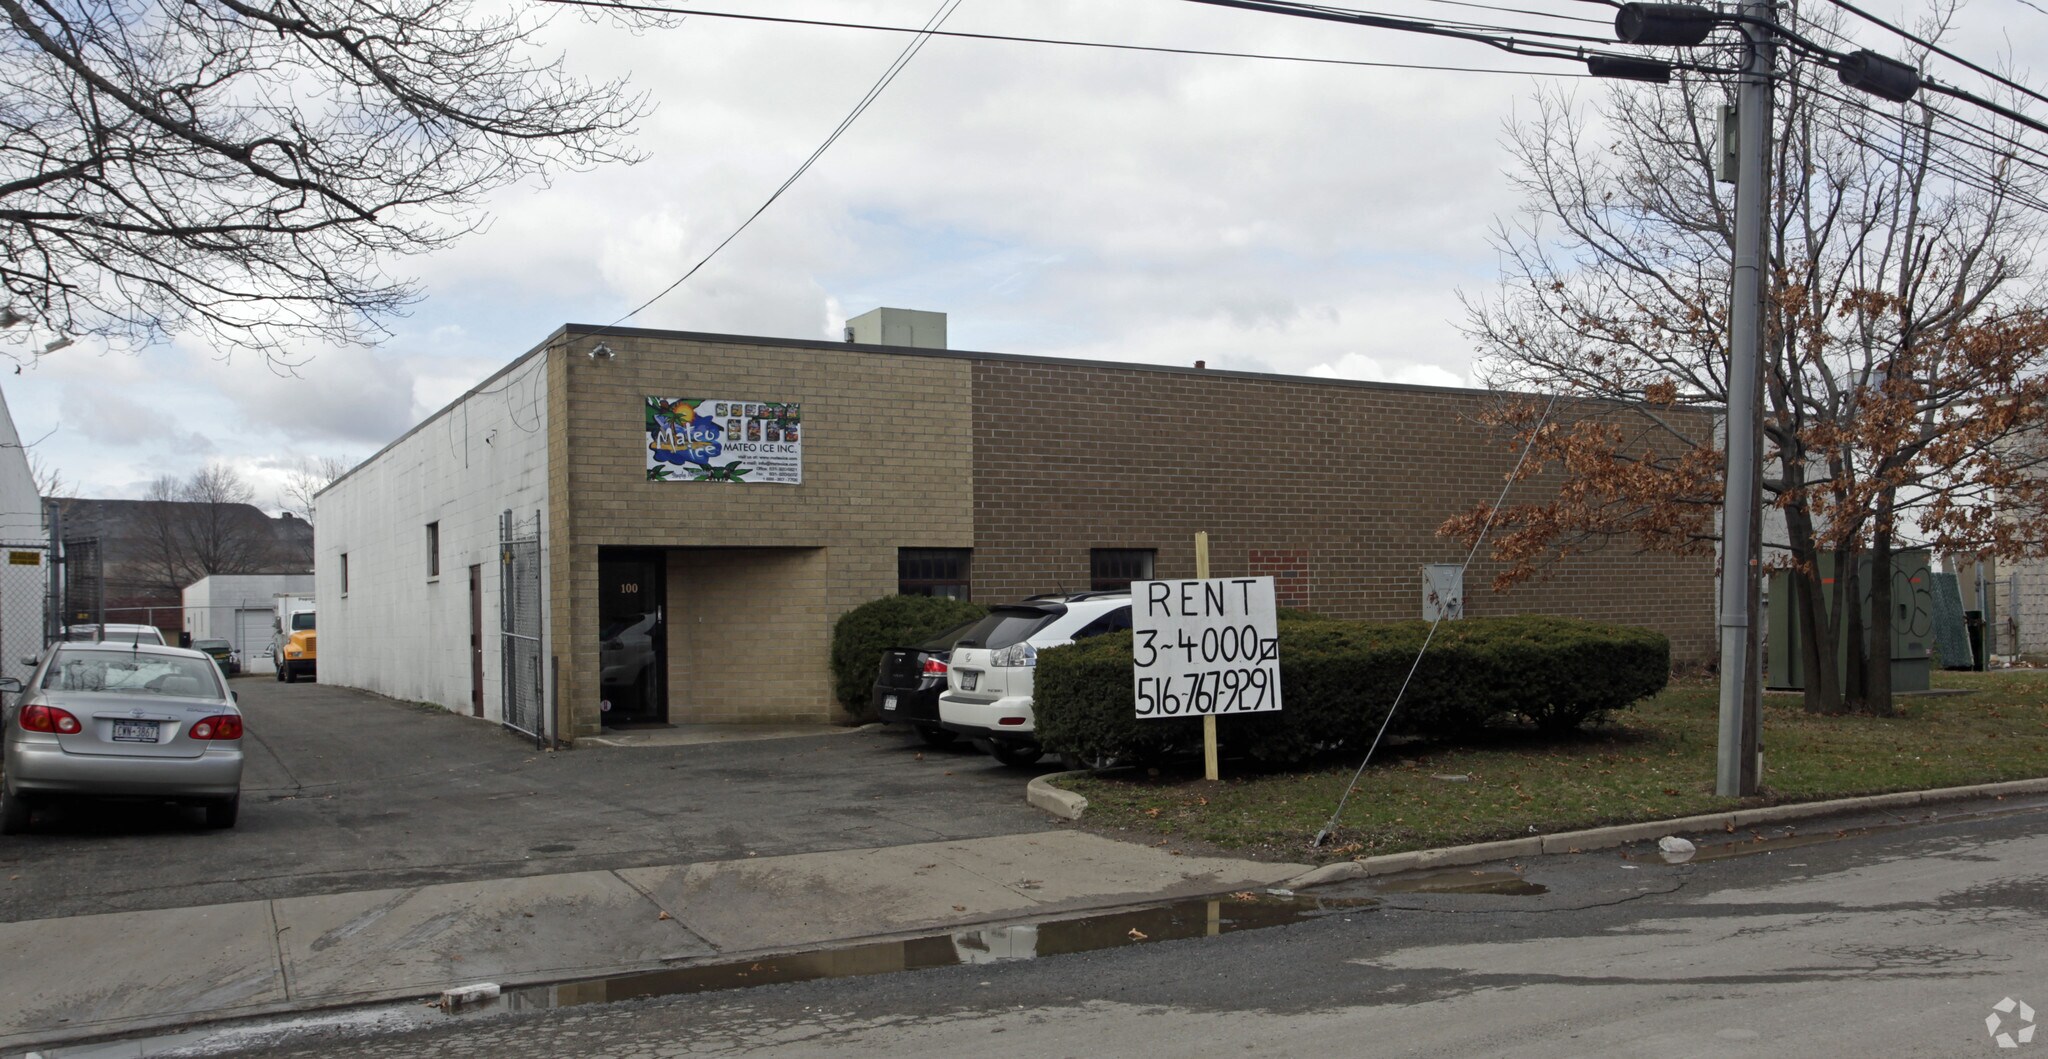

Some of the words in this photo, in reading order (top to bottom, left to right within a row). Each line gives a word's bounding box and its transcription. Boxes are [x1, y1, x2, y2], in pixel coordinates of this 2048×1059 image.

[656, 422, 715, 453] Mateo
[687, 445, 717, 460] ice
[723, 443, 757, 452] MATEO
[760, 444, 774, 453] ICE
[777, 444, 798, 454] INC.
[621, 583, 638, 594] 100
[1149, 579, 1257, 617] RENT
